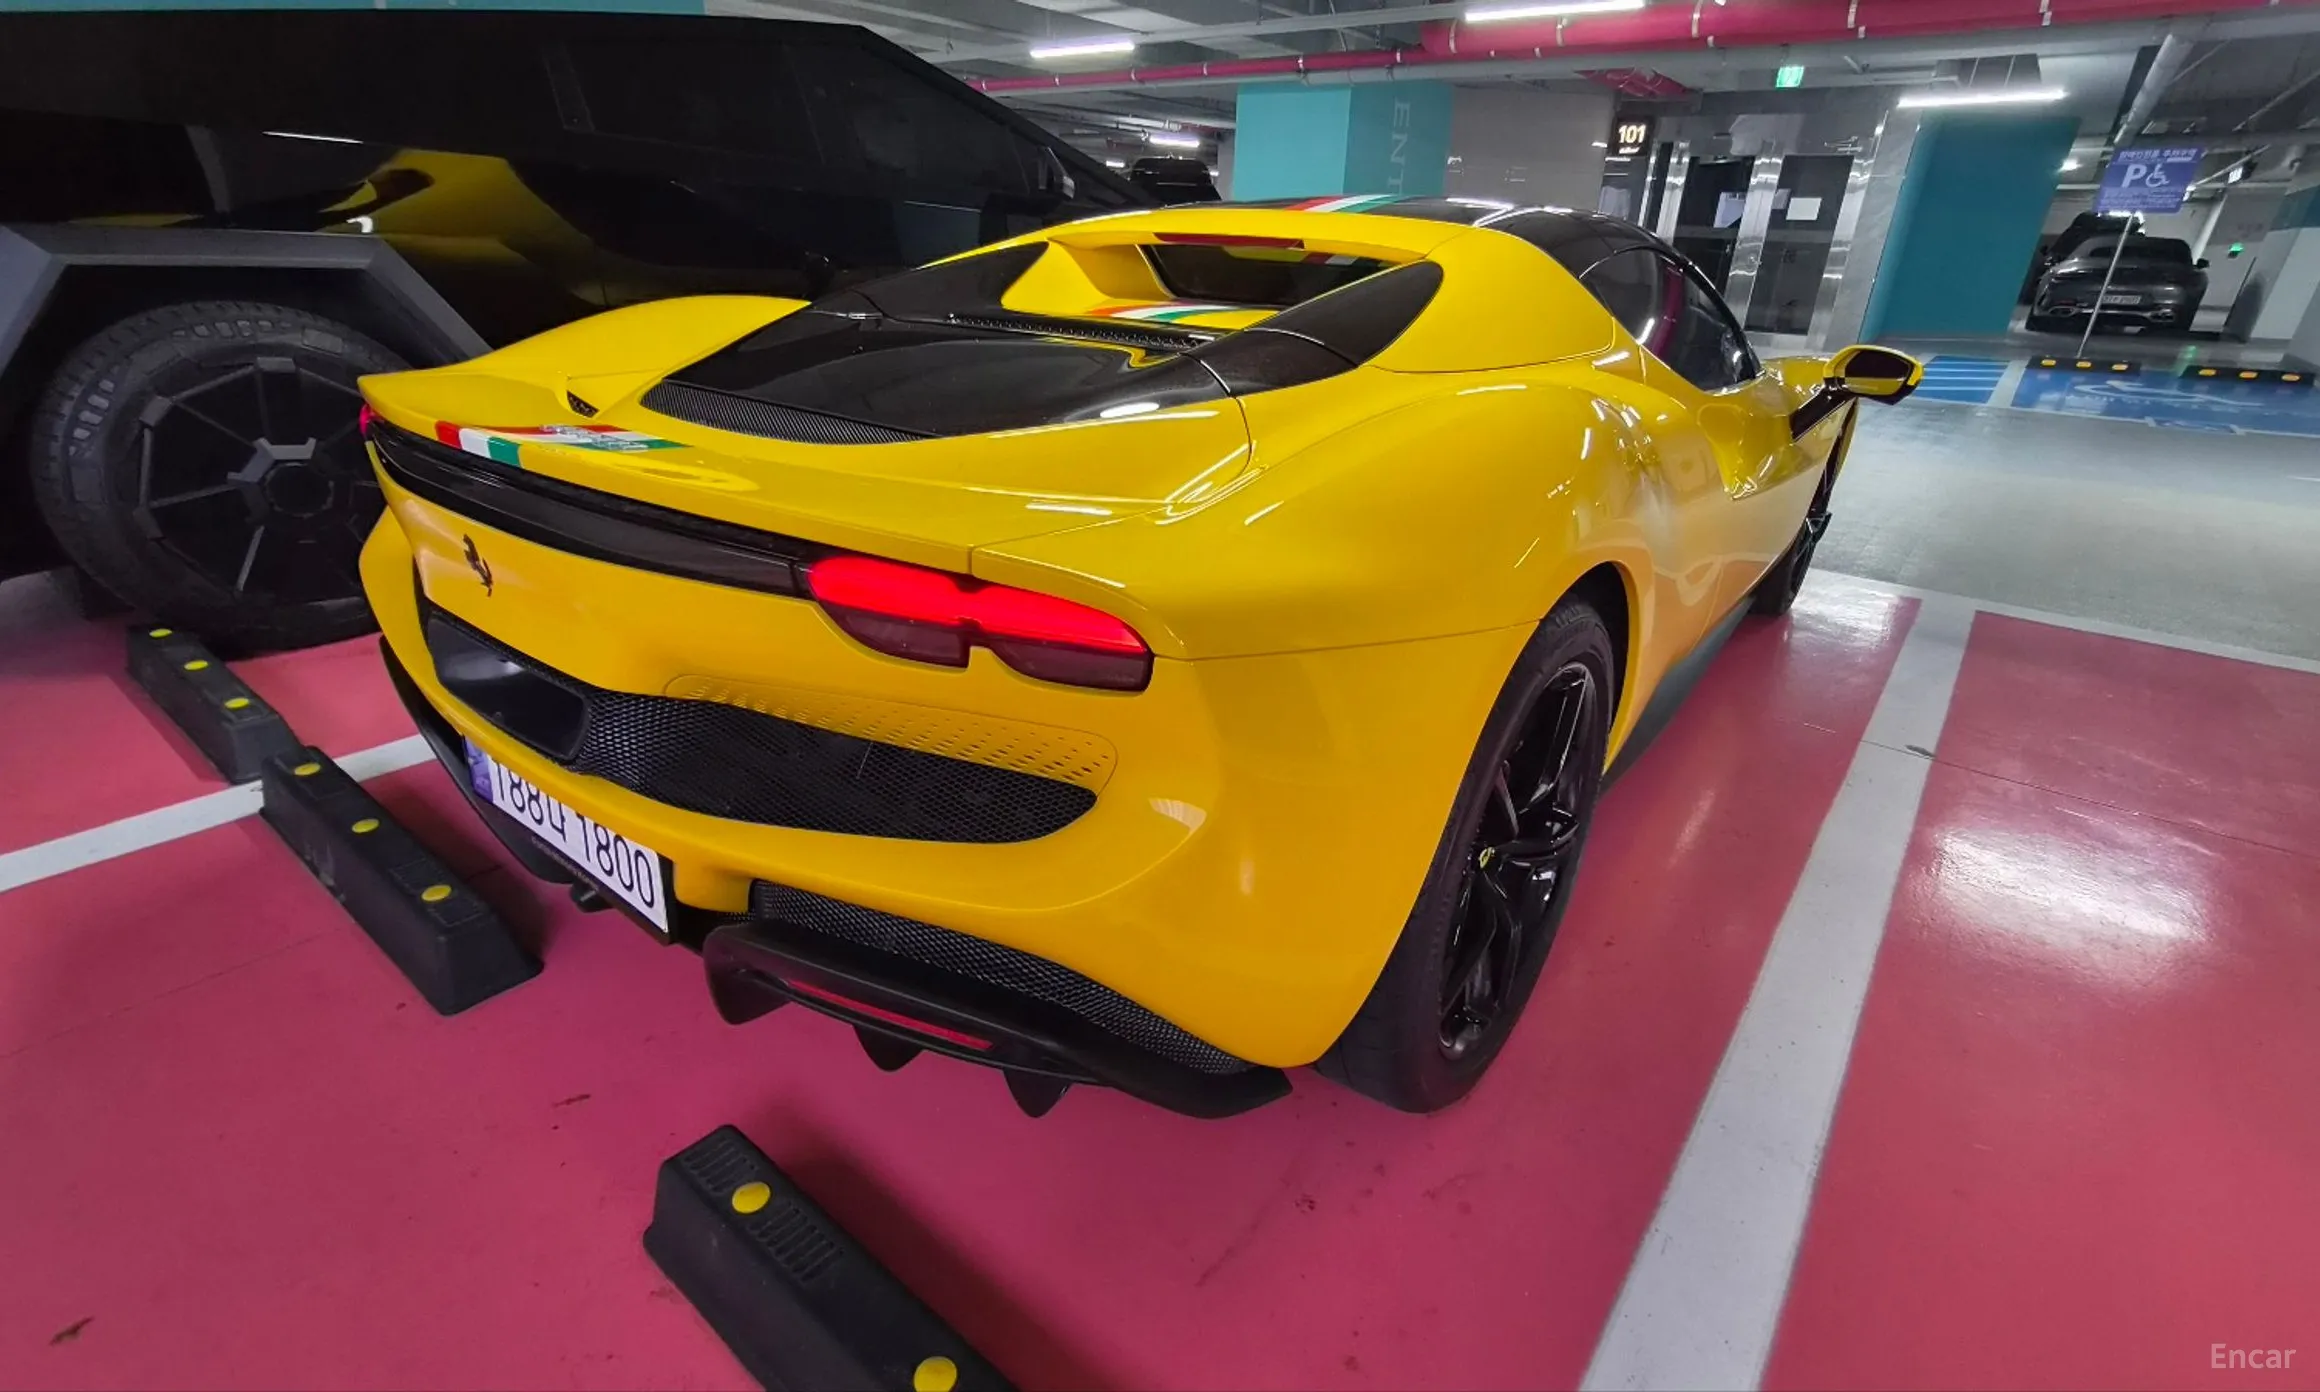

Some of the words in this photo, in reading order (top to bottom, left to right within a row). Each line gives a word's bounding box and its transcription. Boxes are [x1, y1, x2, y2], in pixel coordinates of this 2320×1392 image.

[1618, 124, 1646, 143] 101
[2121, 163, 2147, 188] P
[576, 811, 655, 909] 1800
